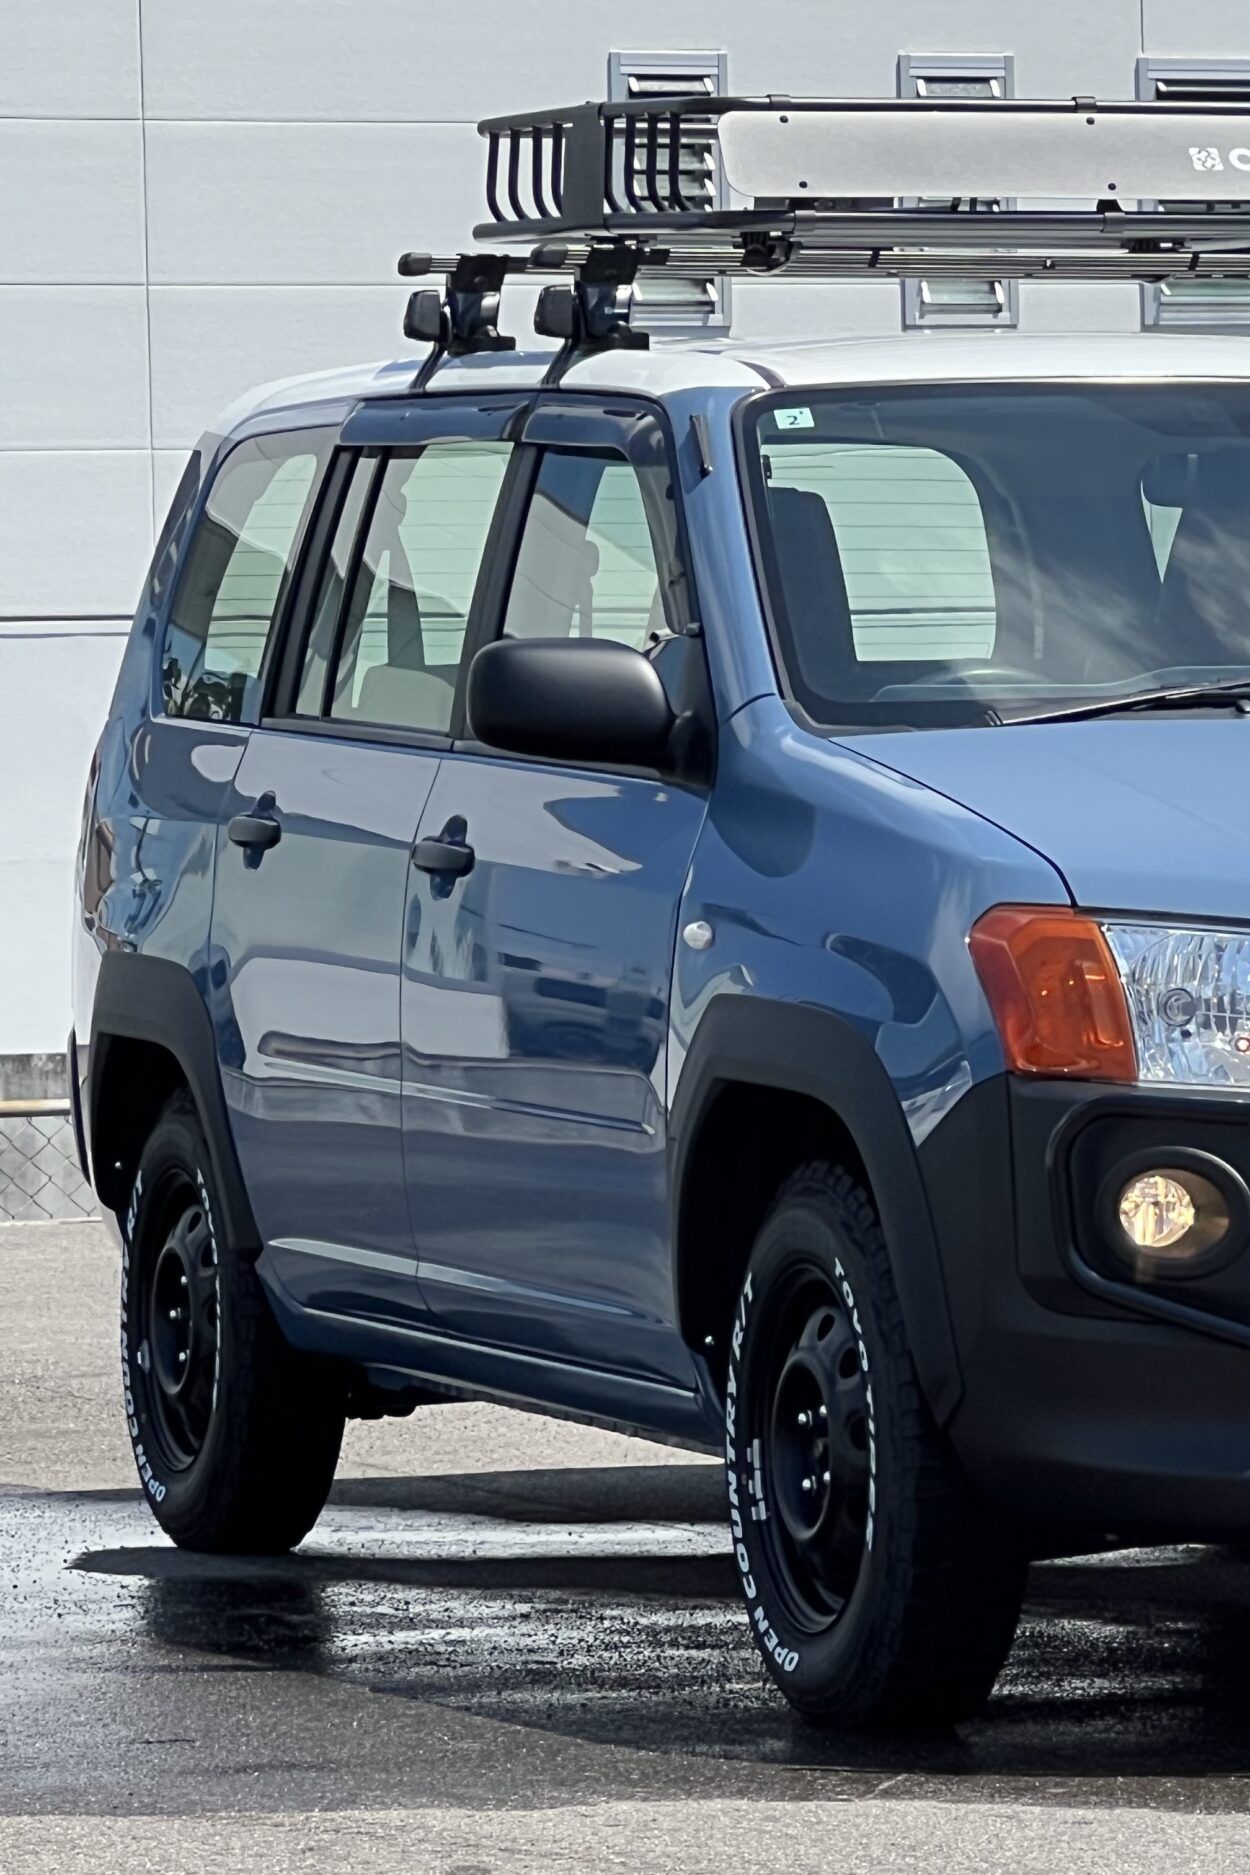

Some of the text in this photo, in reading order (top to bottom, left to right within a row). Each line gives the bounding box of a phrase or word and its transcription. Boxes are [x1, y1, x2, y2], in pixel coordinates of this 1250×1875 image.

[835, 1257, 868, 1372] TOYO
[136, 1444, 166, 1502] OPEN
[726, 1272, 799, 1672] OPEN COUNTRY R/T
